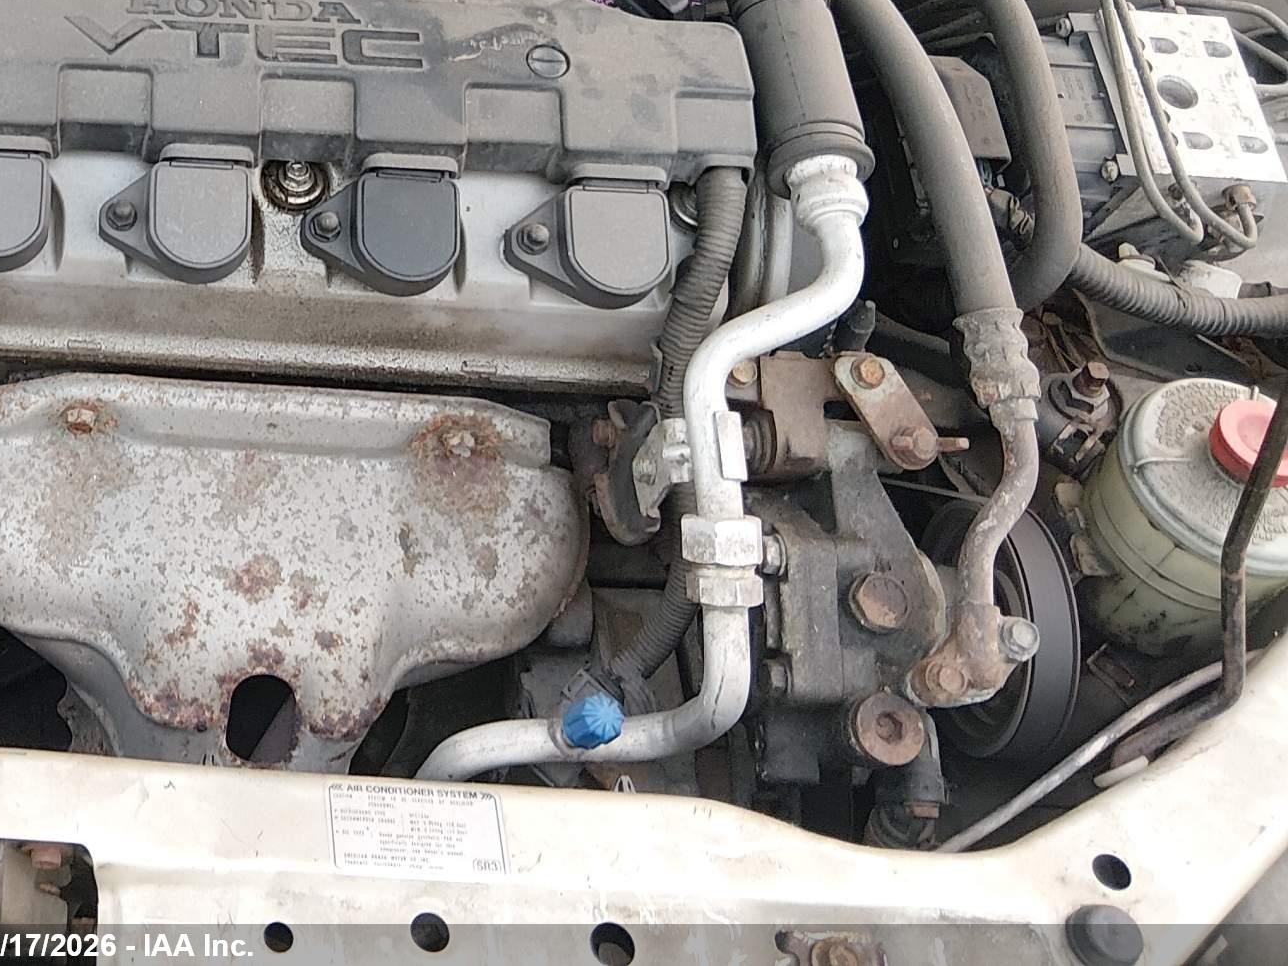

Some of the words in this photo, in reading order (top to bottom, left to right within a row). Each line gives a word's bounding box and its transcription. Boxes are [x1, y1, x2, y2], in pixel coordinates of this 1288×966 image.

[64, 15, 424, 68] VTEC
[346, 785, 363, 793] AIR
[365, 786, 434, 797] CONDITIONER
[437, 788, 478, 799] SYSTEM
